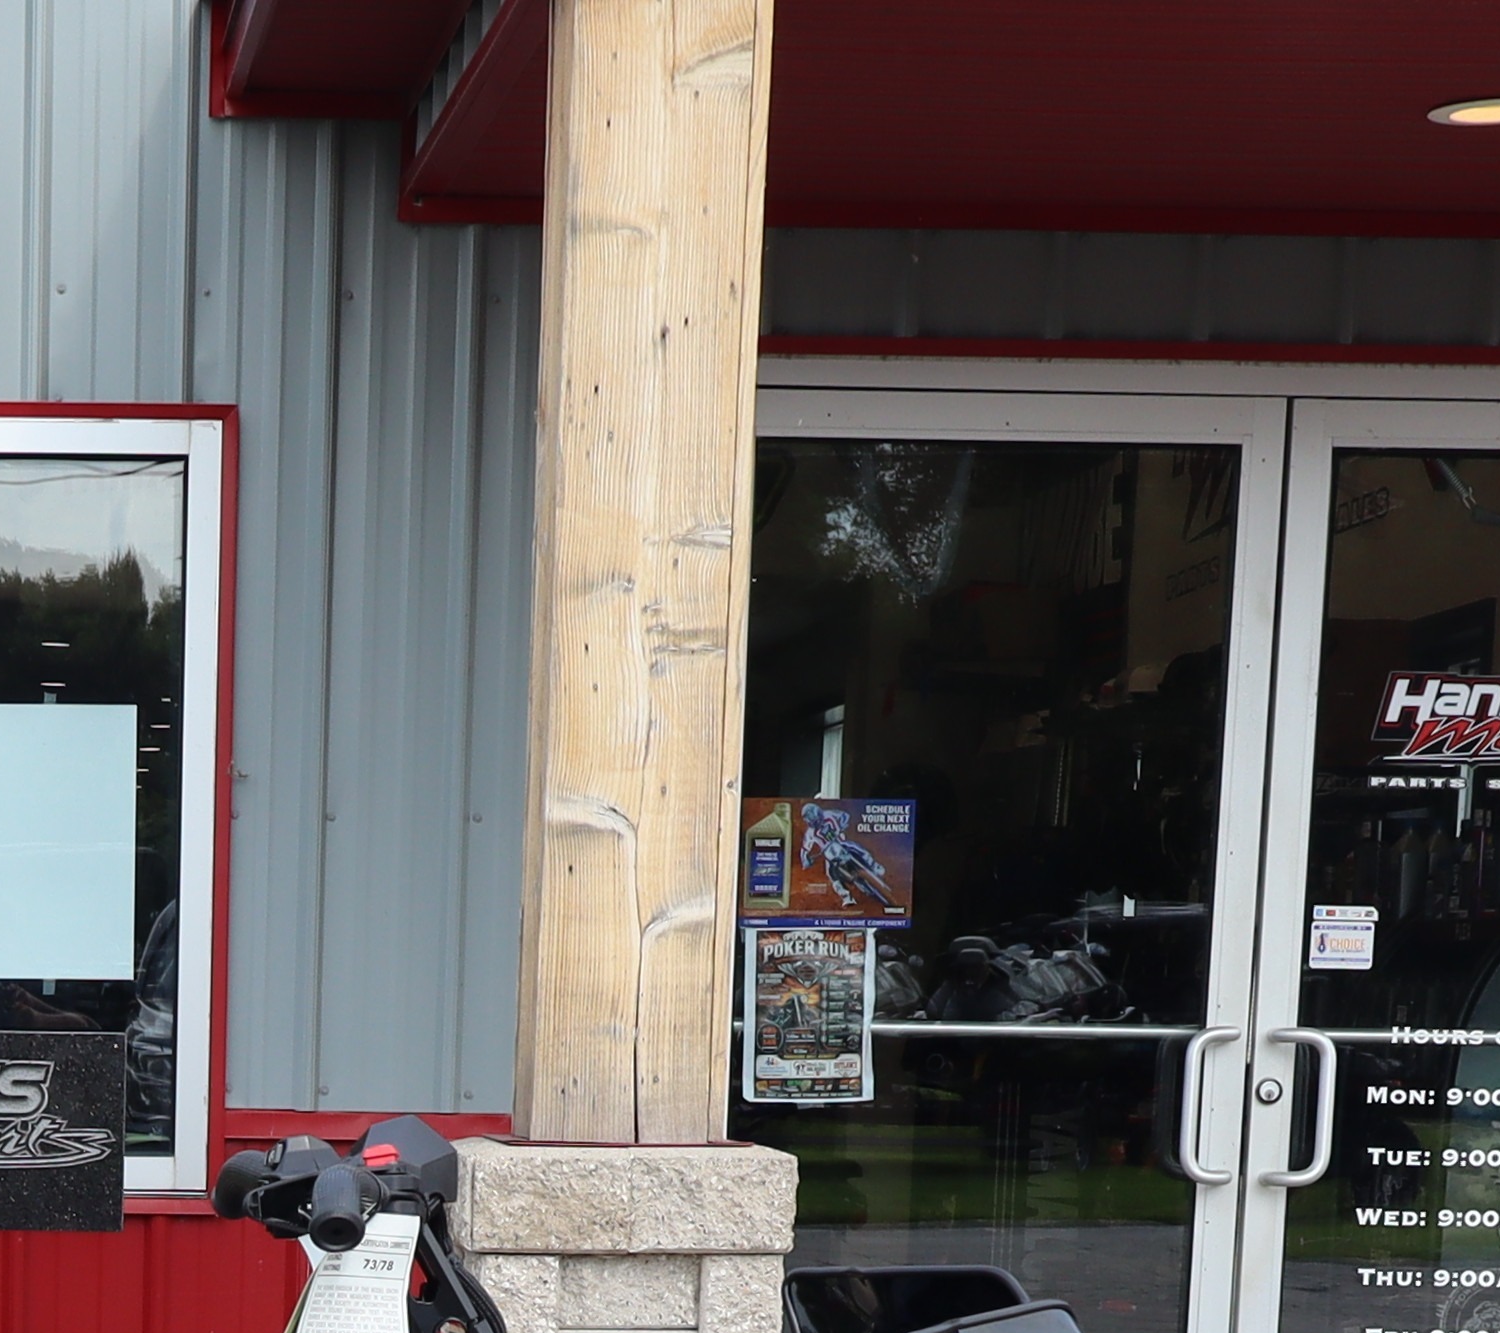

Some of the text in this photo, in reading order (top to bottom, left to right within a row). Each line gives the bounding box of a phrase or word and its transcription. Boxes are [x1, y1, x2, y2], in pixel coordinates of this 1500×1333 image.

[1368, 776, 1468, 790] PARTS
[866, 804, 911, 815] SCHEDULE
[862, 814, 910, 824] YOUR NEXT
[857, 823, 910, 833] OIL CHANGE
[762, 940, 851, 963] POKER RUN
[362, 1258, 395, 1272] 73/78
